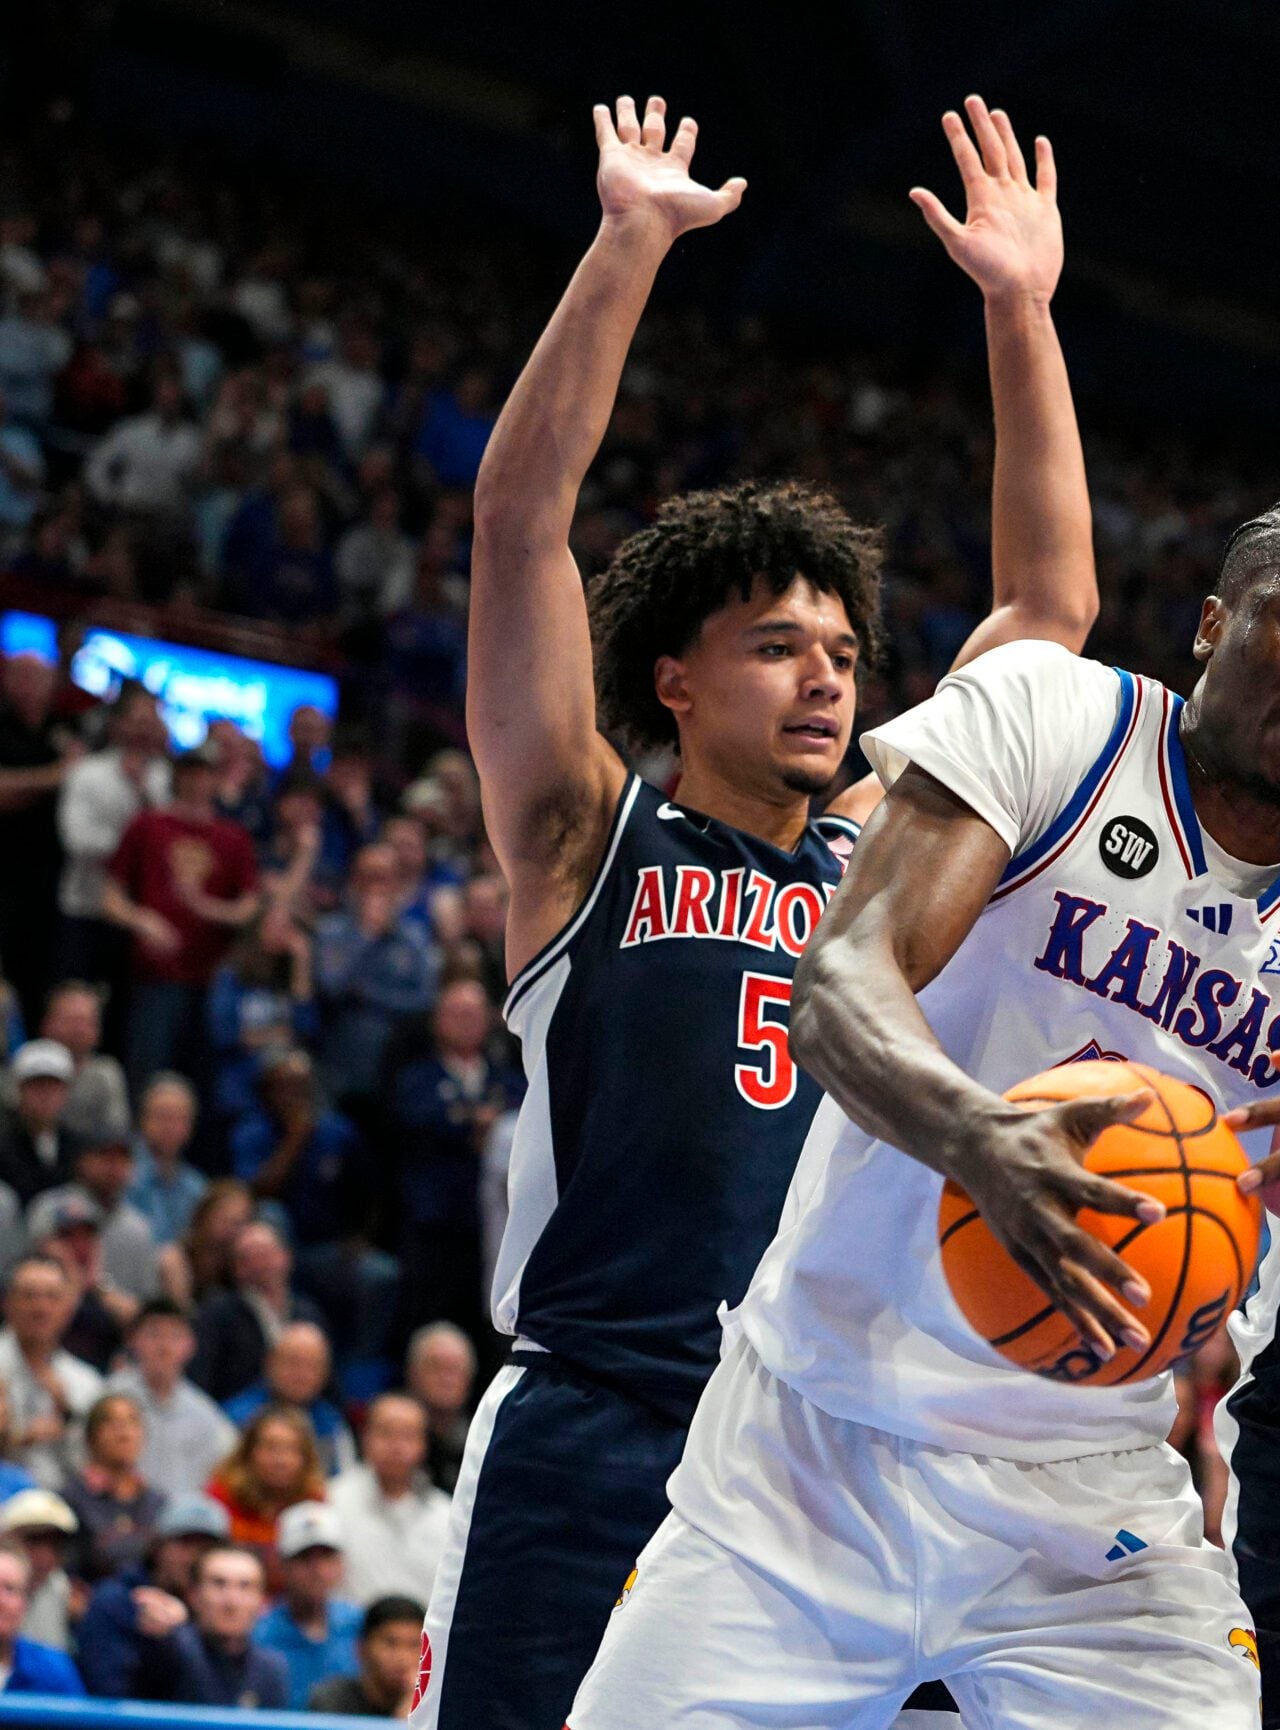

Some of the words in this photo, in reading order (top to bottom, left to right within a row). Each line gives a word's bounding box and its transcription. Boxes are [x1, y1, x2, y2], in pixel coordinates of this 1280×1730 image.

[1105, 823, 1154, 871] SW
[620, 864, 837, 957] ARIZO
[735, 971, 797, 1110] 5
